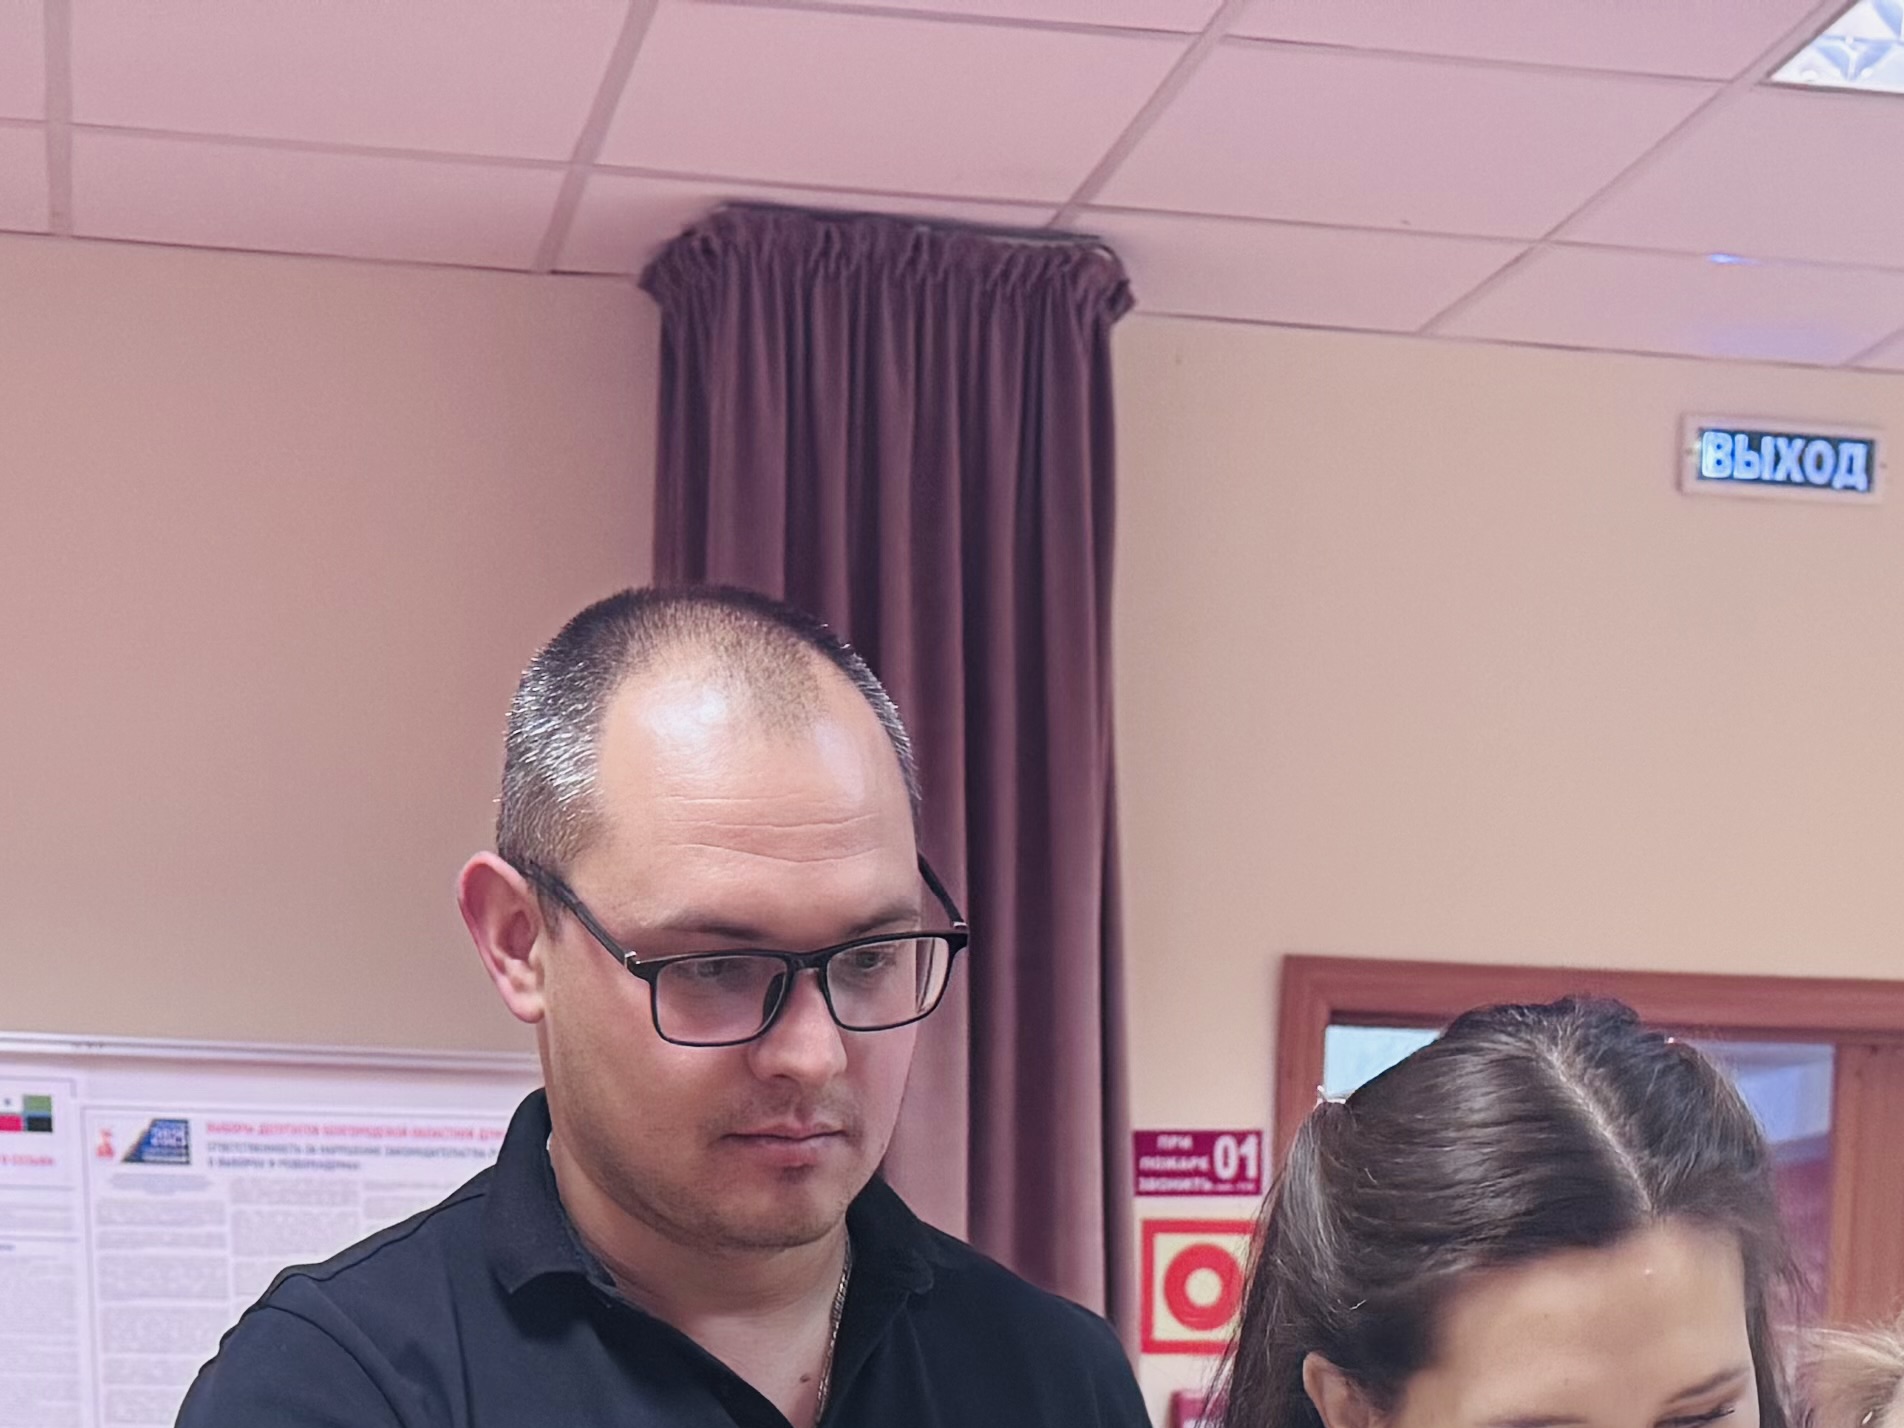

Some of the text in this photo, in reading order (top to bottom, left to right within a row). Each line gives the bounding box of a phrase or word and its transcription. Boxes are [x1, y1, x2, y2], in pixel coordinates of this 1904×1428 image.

[1701, 430, 1869, 492] ВЫХОД
[1156, 1134, 1193, 1150] ПРИ
[1213, 1134, 1258, 1180] 01
